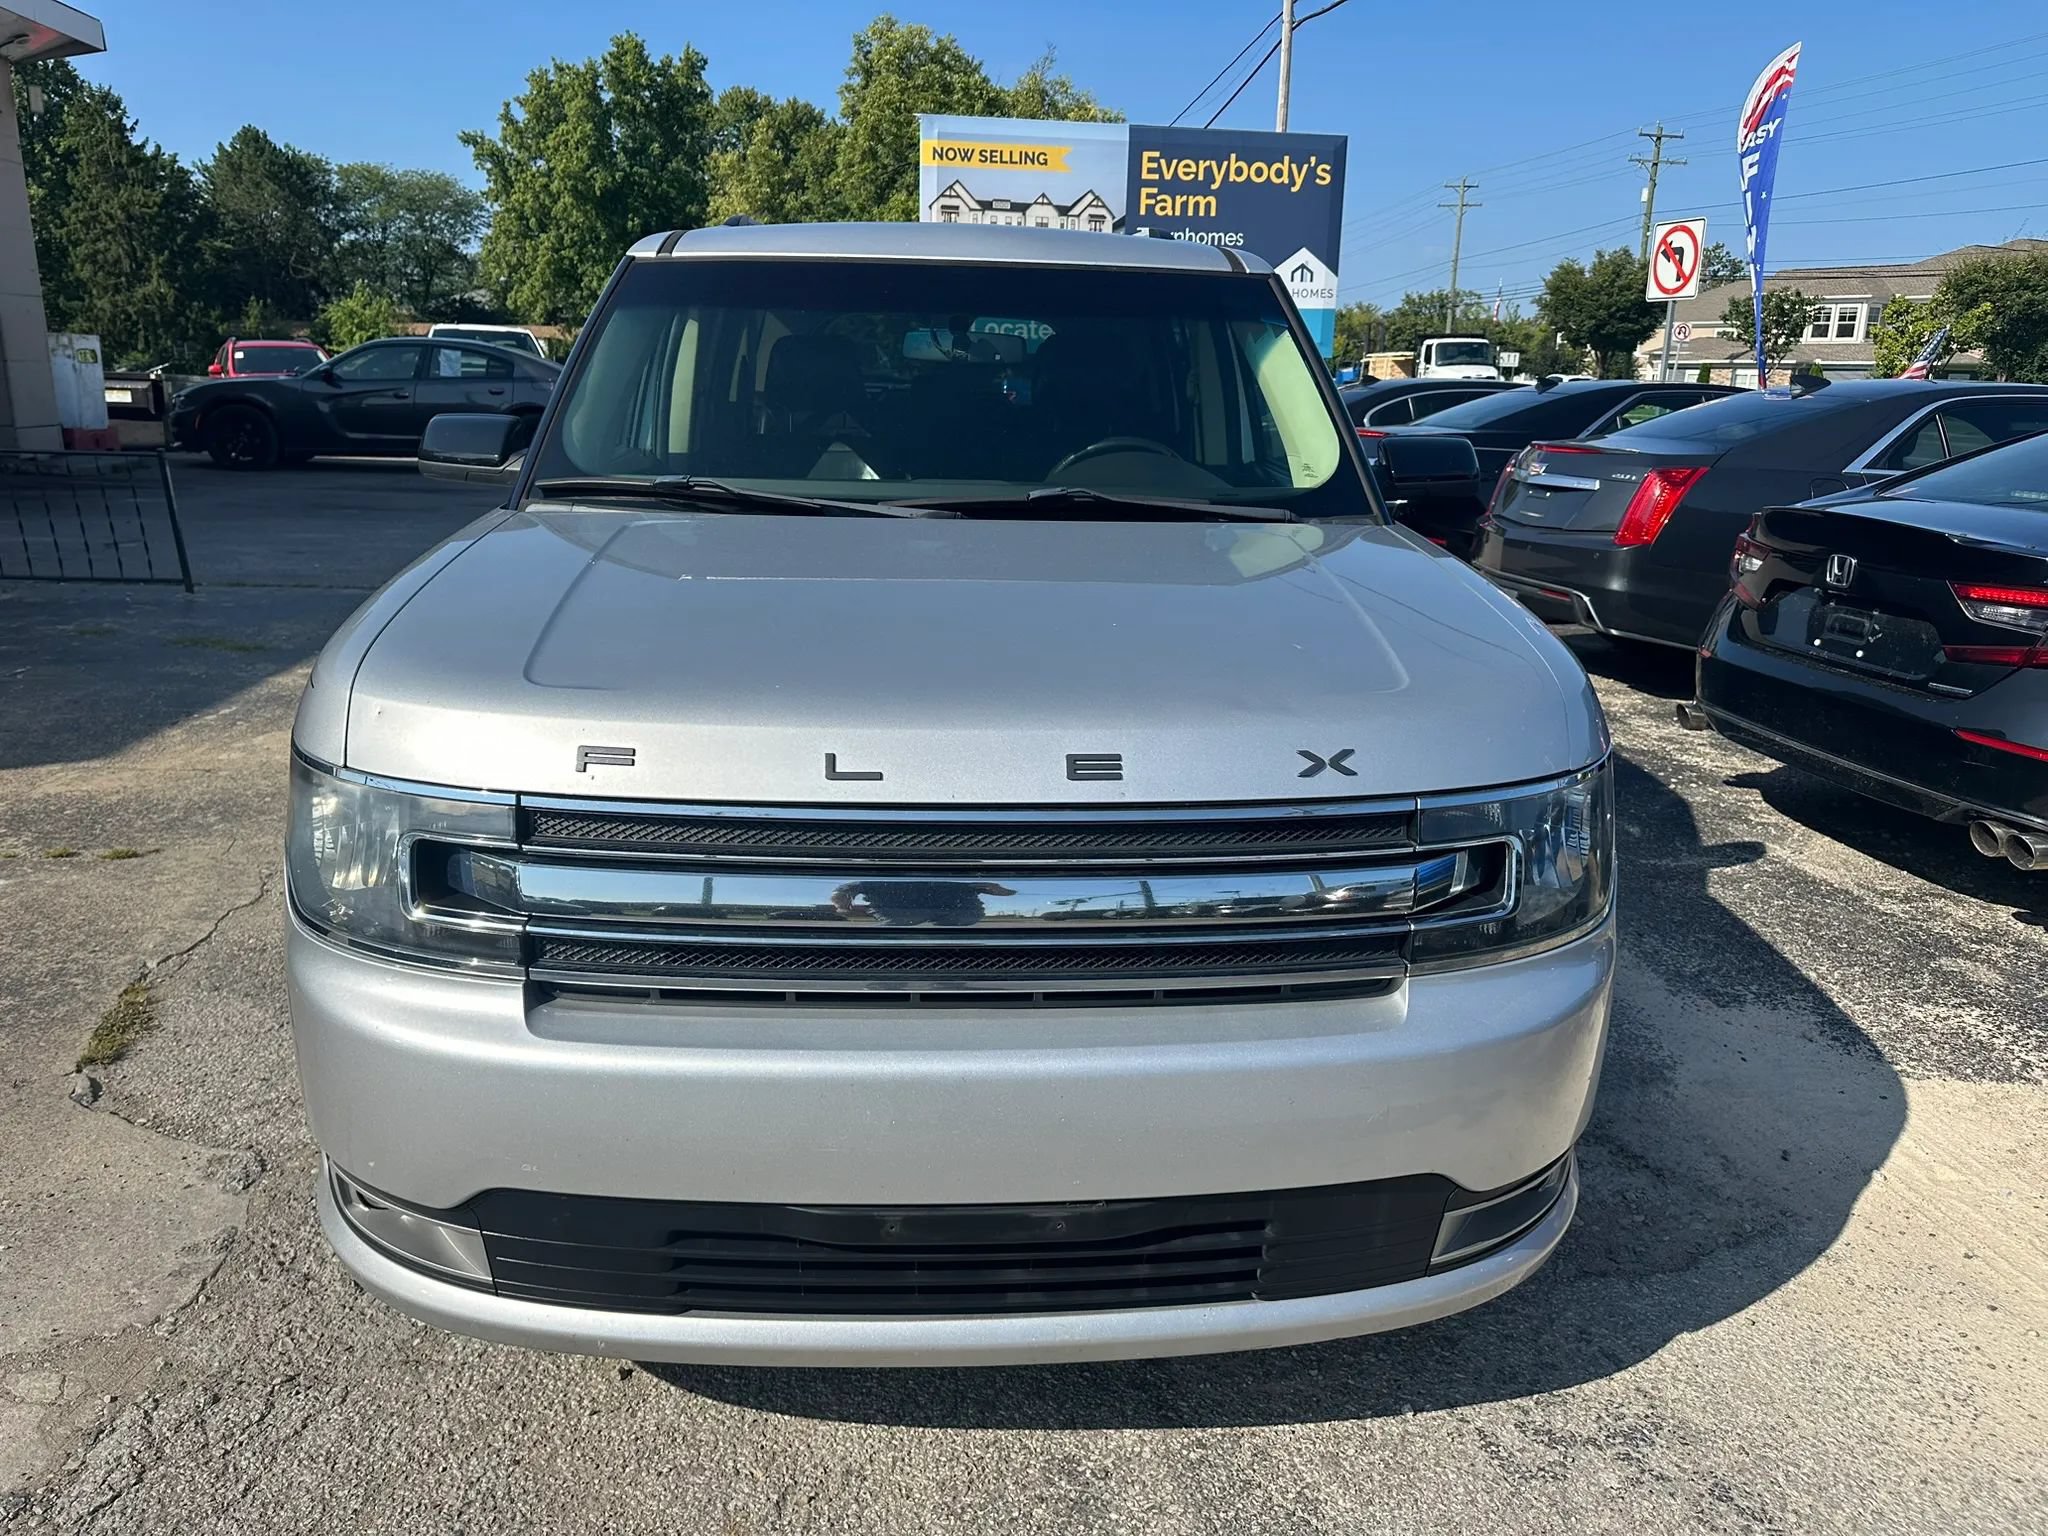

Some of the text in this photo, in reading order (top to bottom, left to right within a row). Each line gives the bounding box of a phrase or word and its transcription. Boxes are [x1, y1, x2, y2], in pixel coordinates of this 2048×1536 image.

[1739, 117, 1783, 153] ASY
[932, 147, 1049, 166] NOW SELLING
[1139, 187, 1217, 217] Farm
[1291, 288, 1334, 299] HOMES
[969, 320, 1056, 340] ocate
[576, 745, 1358, 781] FLEX
